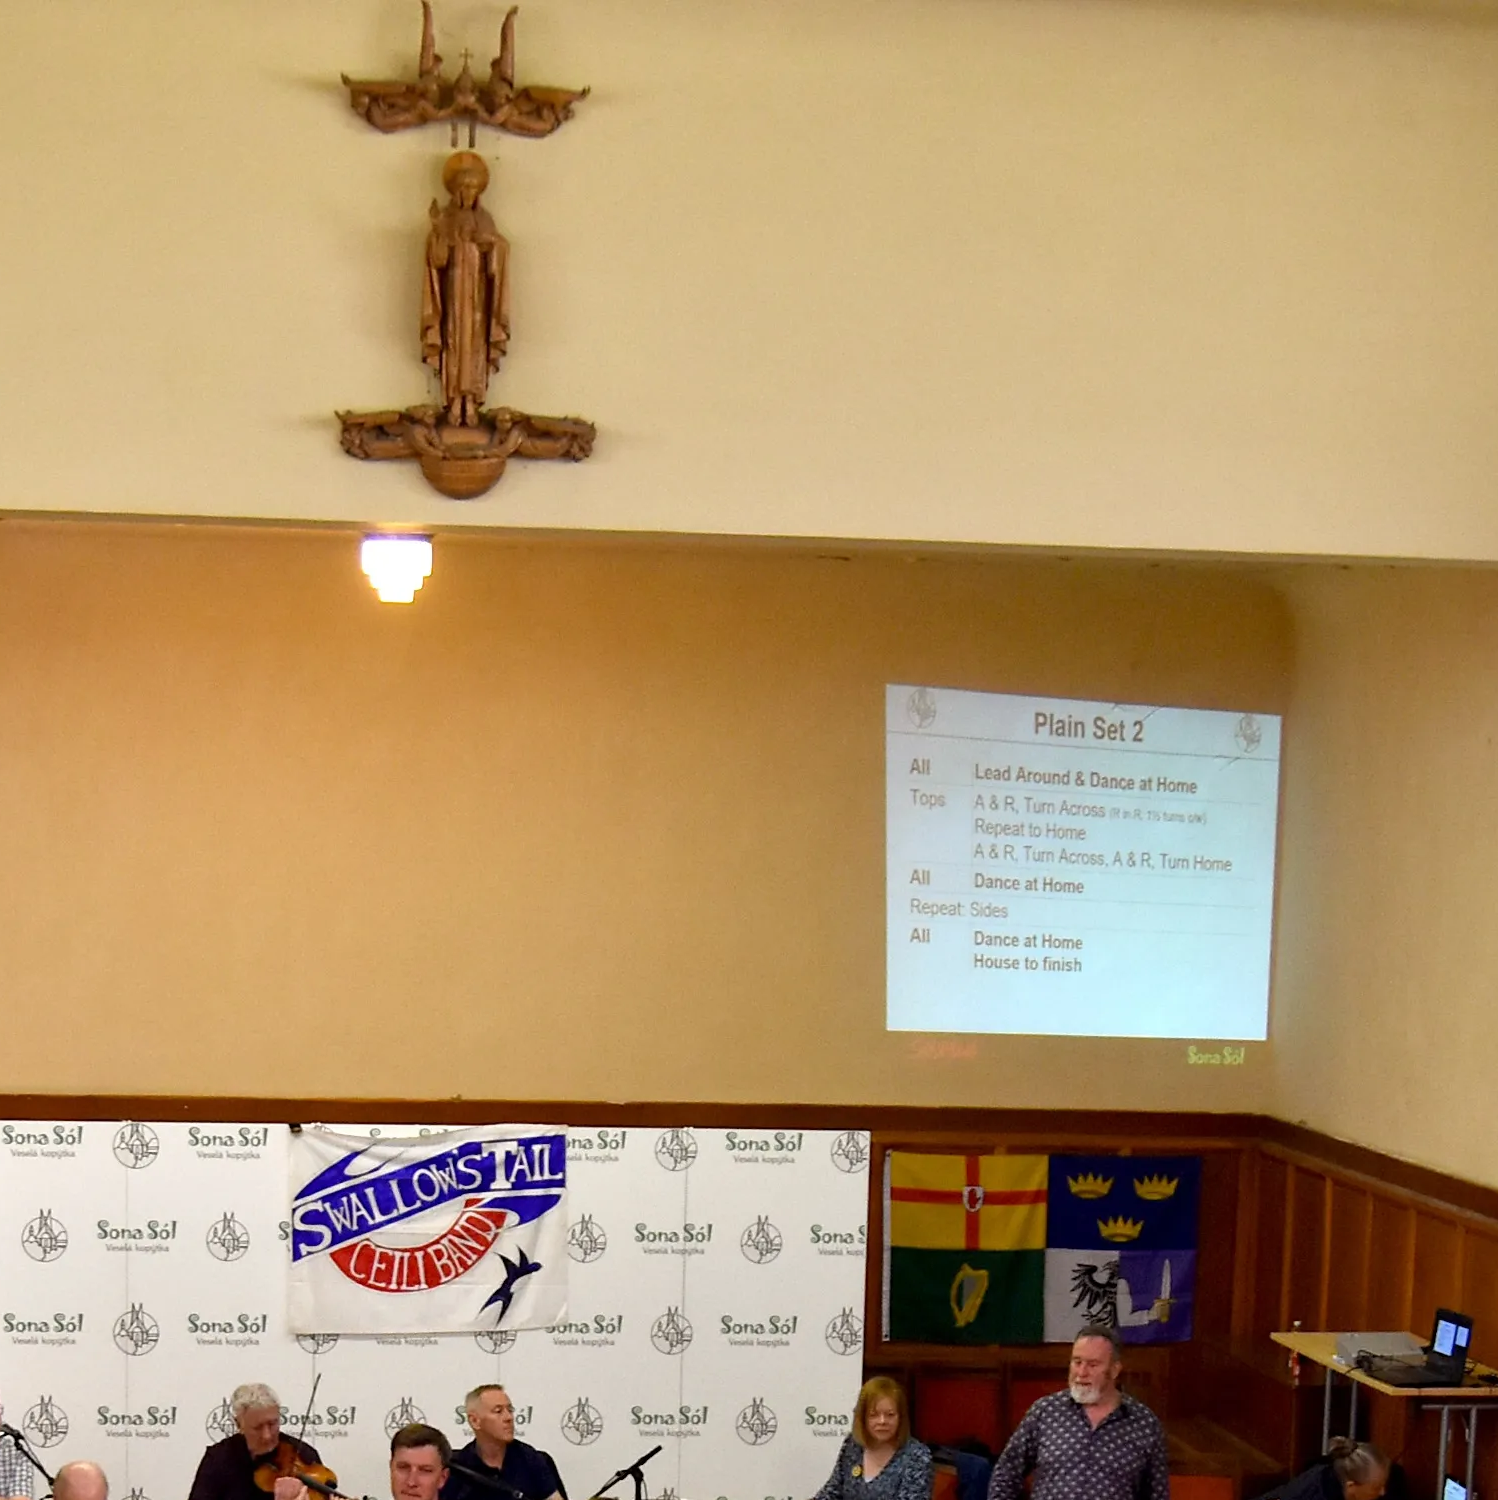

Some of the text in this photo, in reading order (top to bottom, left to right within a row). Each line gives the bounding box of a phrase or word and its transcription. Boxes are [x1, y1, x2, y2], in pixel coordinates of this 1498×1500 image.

[1034, 712, 1144, 742] Plain Set 2
[910, 758, 930, 775] All
[975, 763, 1198, 794] Lead Around & Dance at Home
[910, 789, 946, 809] Tops
[974, 794, 985, 810] A
[989, 795, 999, 810] &
[1004, 796, 1019, 814] R,
[1024, 797, 1054, 814] Turn
[1059, 800, 1106, 818] Across
[974, 818, 1086, 840] Repeat to Home
[974, 843, 985, 859] A
[988, 844, 999, 860] &
[1023, 845, 1054, 862] Turn
[1059, 848, 1108, 867] Across,
[1113, 851, 1123, 867] A
[1127, 852, 1136, 867] &
[1160, 853, 1189, 869] Turn
[1194, 855, 1232, 872] Home
[910, 870, 930, 885] All
[974, 873, 1084, 893] Dance at Home
[970, 902, 1008, 918] Sides
[974, 931, 1083, 950] Dance at Home
[974, 954, 1082, 972] House to finish
[2, 1125, 83, 1145] Sona Sól
[188, 1126, 268, 1147] Sona Sól
[597, 1130, 626, 1150] Sól
[725, 1131, 803, 1152] Sona Sól
[11, 1149, 37, 1158] Veselá
[197, 1151, 223, 1159] Veselá
[733, 1156, 758, 1164] Veselá
[97, 1220, 177, 1240] Sona Sól
[634, 1223, 713, 1243] Sona Sól
[810, 1224, 854, 1244] Sona
[106, 1244, 132, 1252] Veselá
[350, 1211, 499, 1290] CEILI BAND
[643, 1247, 668, 1255] Veselá
[3, 1313, 83, 1333] Sona Sól
[188, 1313, 267, 1334] Sona Sól
[593, 1315, 623, 1334] Sól
[721, 1315, 798, 1335] Sona Sól
[12, 1337, 38, 1345] Veselá
[196, 1337, 223, 1346] Veselá
[553, 1338, 579, 1346] Veselá
[728, 1338, 754, 1346] Veselá
[97, 1406, 177, 1426] Sona Sól
[327, 1406, 356, 1426] Sól
[516, 1406, 533, 1424] ól
[631, 1405, 708, 1425] Sona Sól
[805, 1406, 849, 1425] Sona
[106, 1429, 132, 1438] Veselá
[638, 1429, 664, 1437] Veselá
